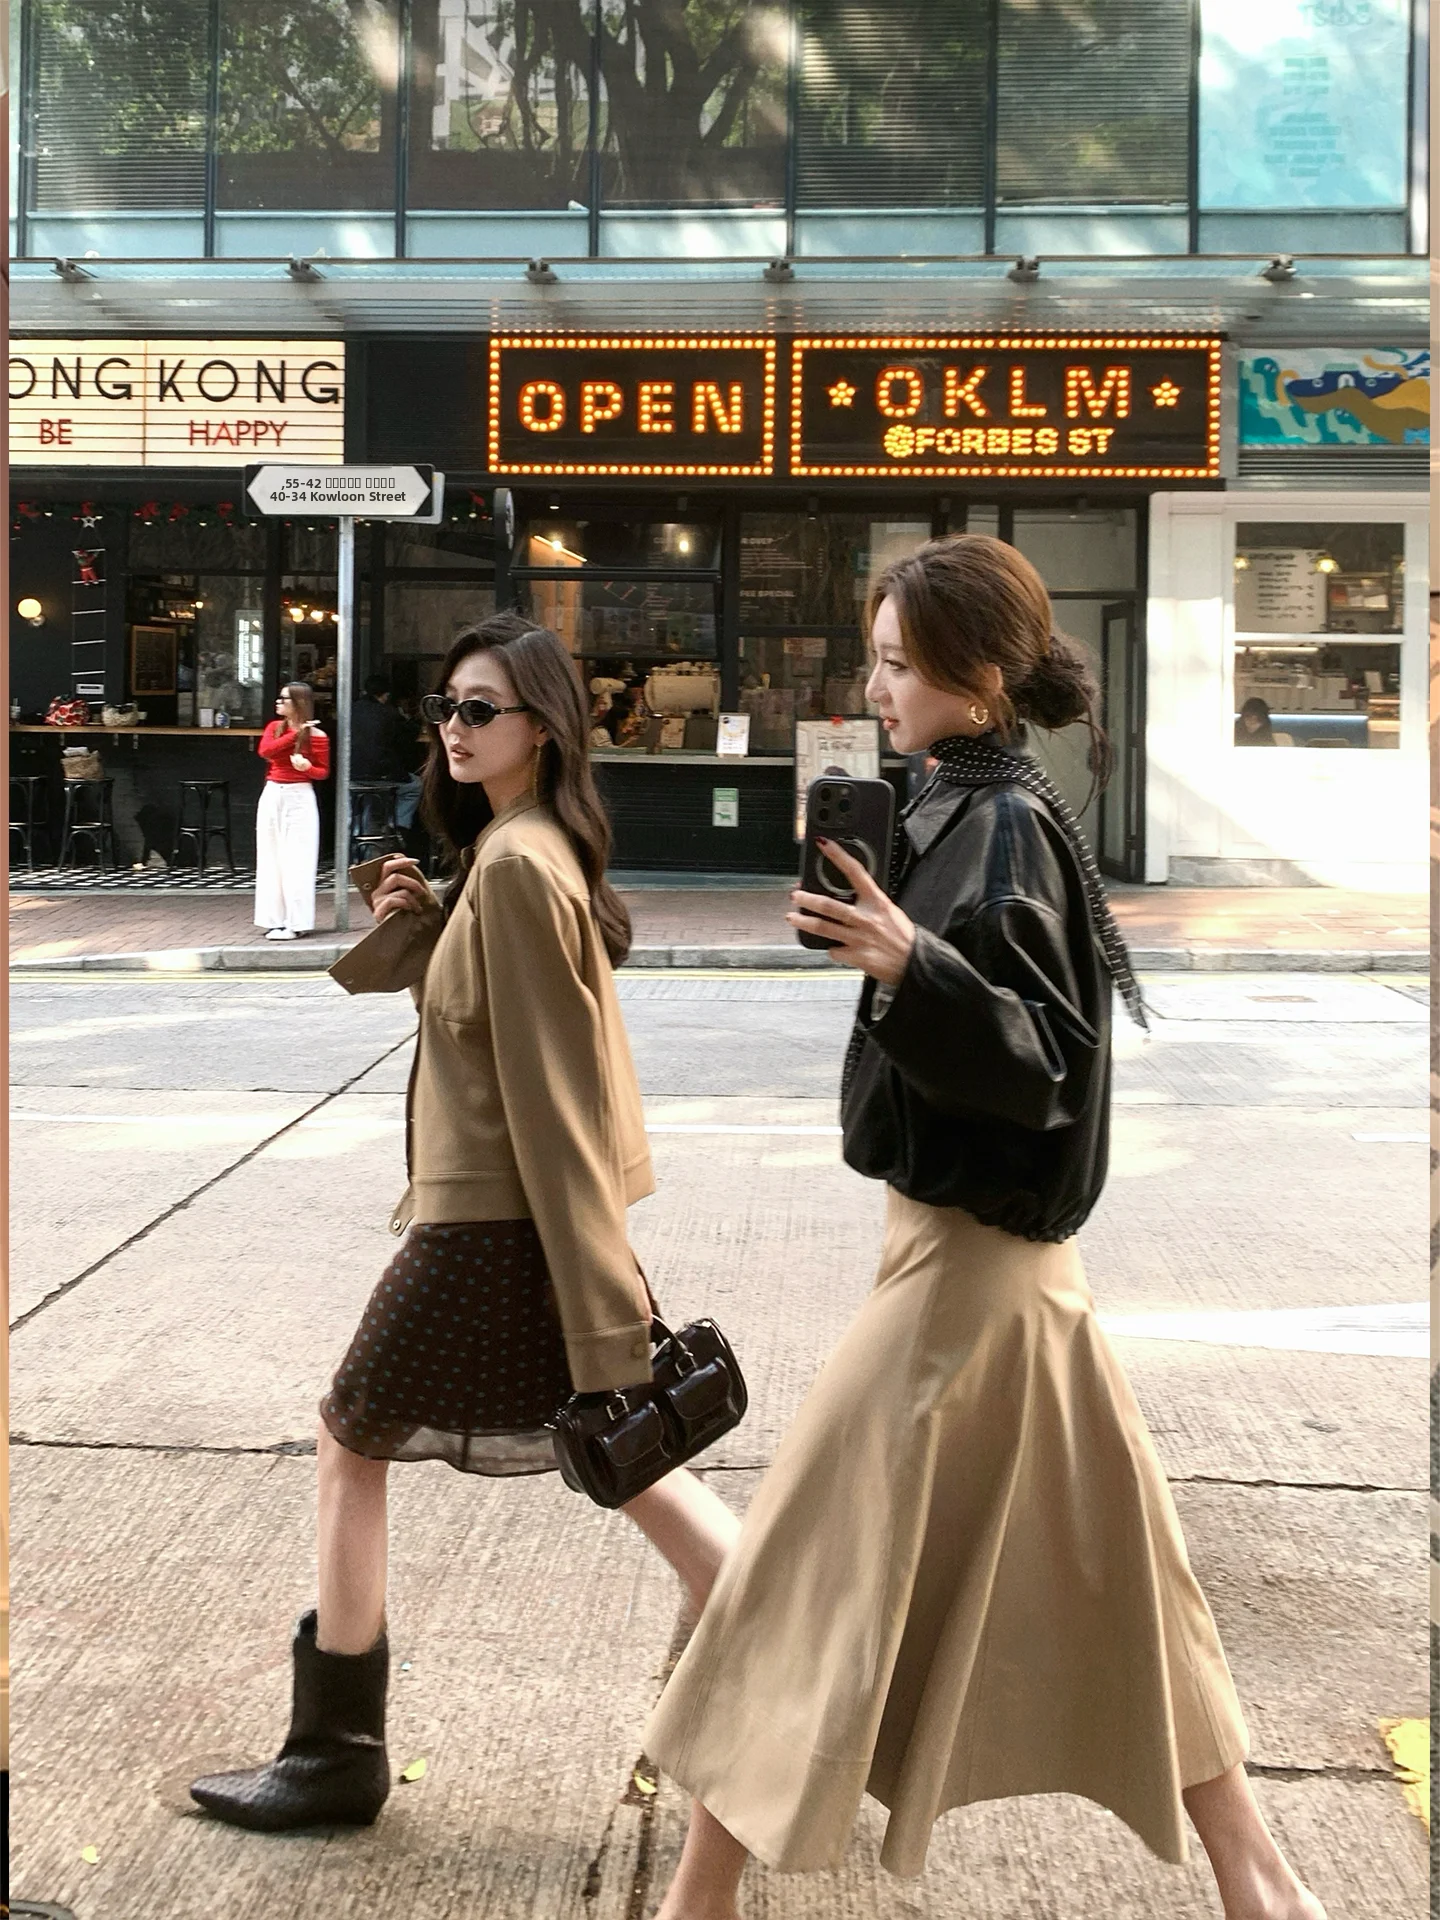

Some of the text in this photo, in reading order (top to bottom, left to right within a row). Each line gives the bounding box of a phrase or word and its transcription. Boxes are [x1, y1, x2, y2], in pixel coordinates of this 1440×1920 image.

[159, 359, 340, 404] KONG
[877, 366, 1132, 418] OKLM
[519, 381, 743, 433] OPEN
[39, 418, 288, 447] BE HAPPY
[1067, 427, 1115, 456] ST
[270, 491, 406, 502] 40-34 Kowloon Street
[281, 478, 322, 490] ,55-42
